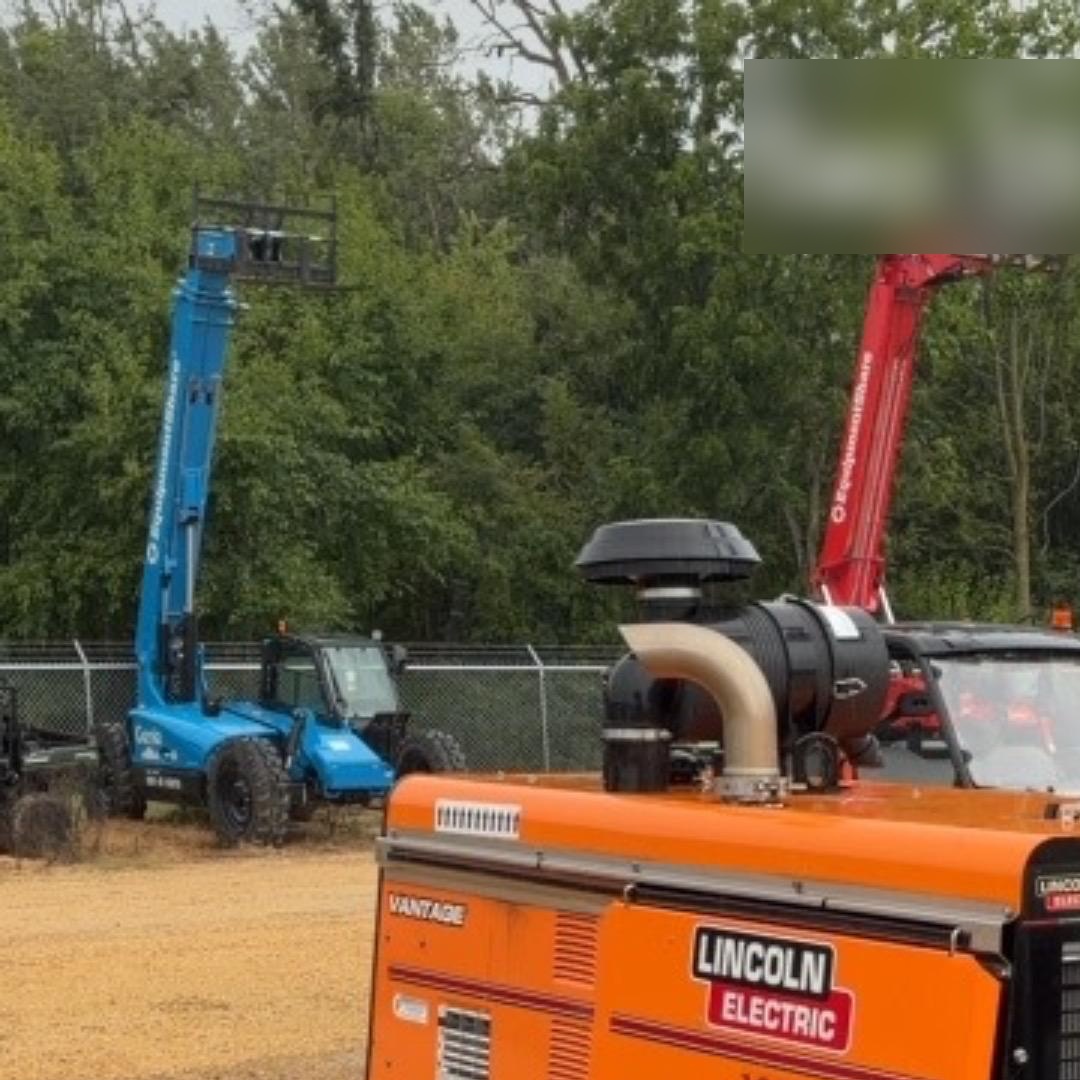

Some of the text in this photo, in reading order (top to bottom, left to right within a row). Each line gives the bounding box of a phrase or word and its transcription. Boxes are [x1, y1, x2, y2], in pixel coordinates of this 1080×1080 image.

[388, 892, 466, 925] VANTAGE
[698, 934, 827, 993] LINCOLN
[721, 991, 837, 1041] ELECTRIC
